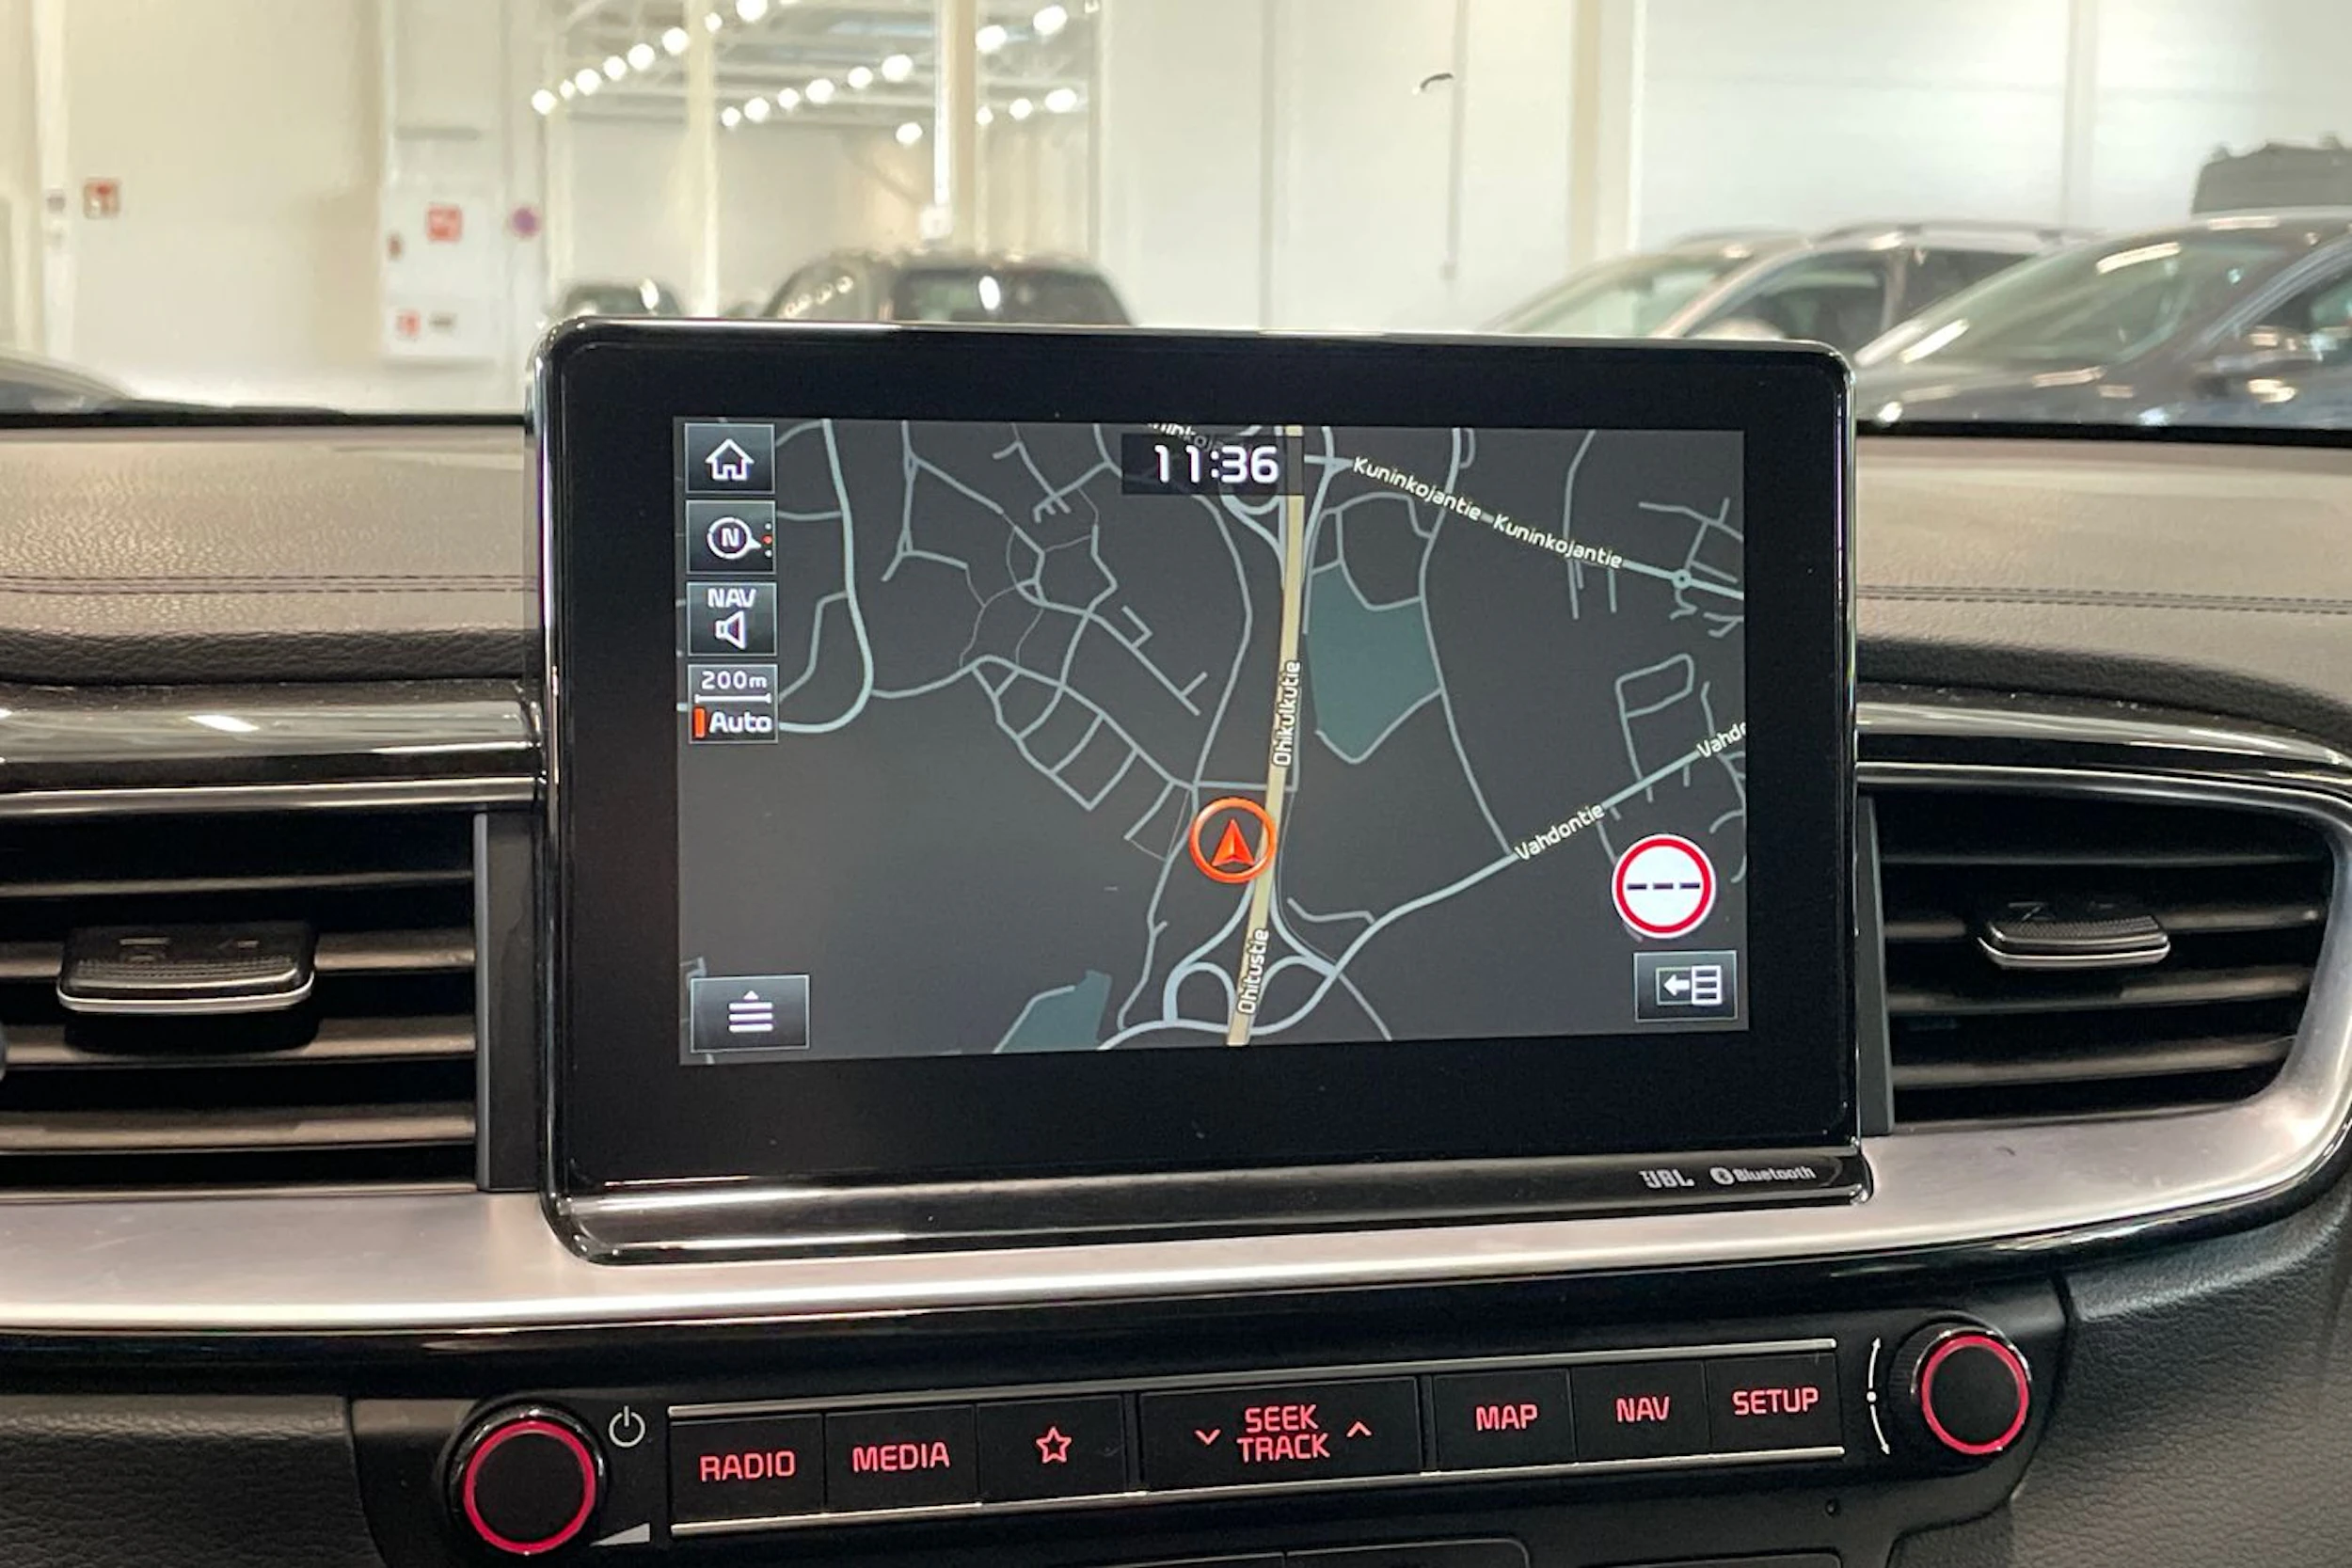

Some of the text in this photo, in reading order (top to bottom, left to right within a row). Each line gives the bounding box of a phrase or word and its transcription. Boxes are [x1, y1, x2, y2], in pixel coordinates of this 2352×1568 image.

[1154, 444, 1279, 483] 11:36
[1353, 455, 1482, 521] Kuninkojantie
[721, 527, 739, 547] N
[1493, 514, 1623, 569] Kuninkojantie
[707, 588, 756, 609] NAV
[701, 670, 768, 690] 200m
[708, 710, 773, 734] Auto
[1272, 660, 1301, 767] Ohikulkutie
[1514, 802, 1606, 861] Vahdontie
[1237, 928, 1270, 1015] Ohitustie
[1639, 1168, 1694, 1188] JBL
[1732, 1165, 1817, 1182] Bluetooth
[1615, 1396, 1671, 1423] NAV
[1732, 1387, 1820, 1417] SETUP
[1244, 1403, 1318, 1433] SEEK
[1474, 1404, 1539, 1433] MAP
[851, 1441, 951, 1474] MEDIA
[1236, 1432, 1331, 1464] TRACK
[699, 1449, 797, 1482] RADIO
